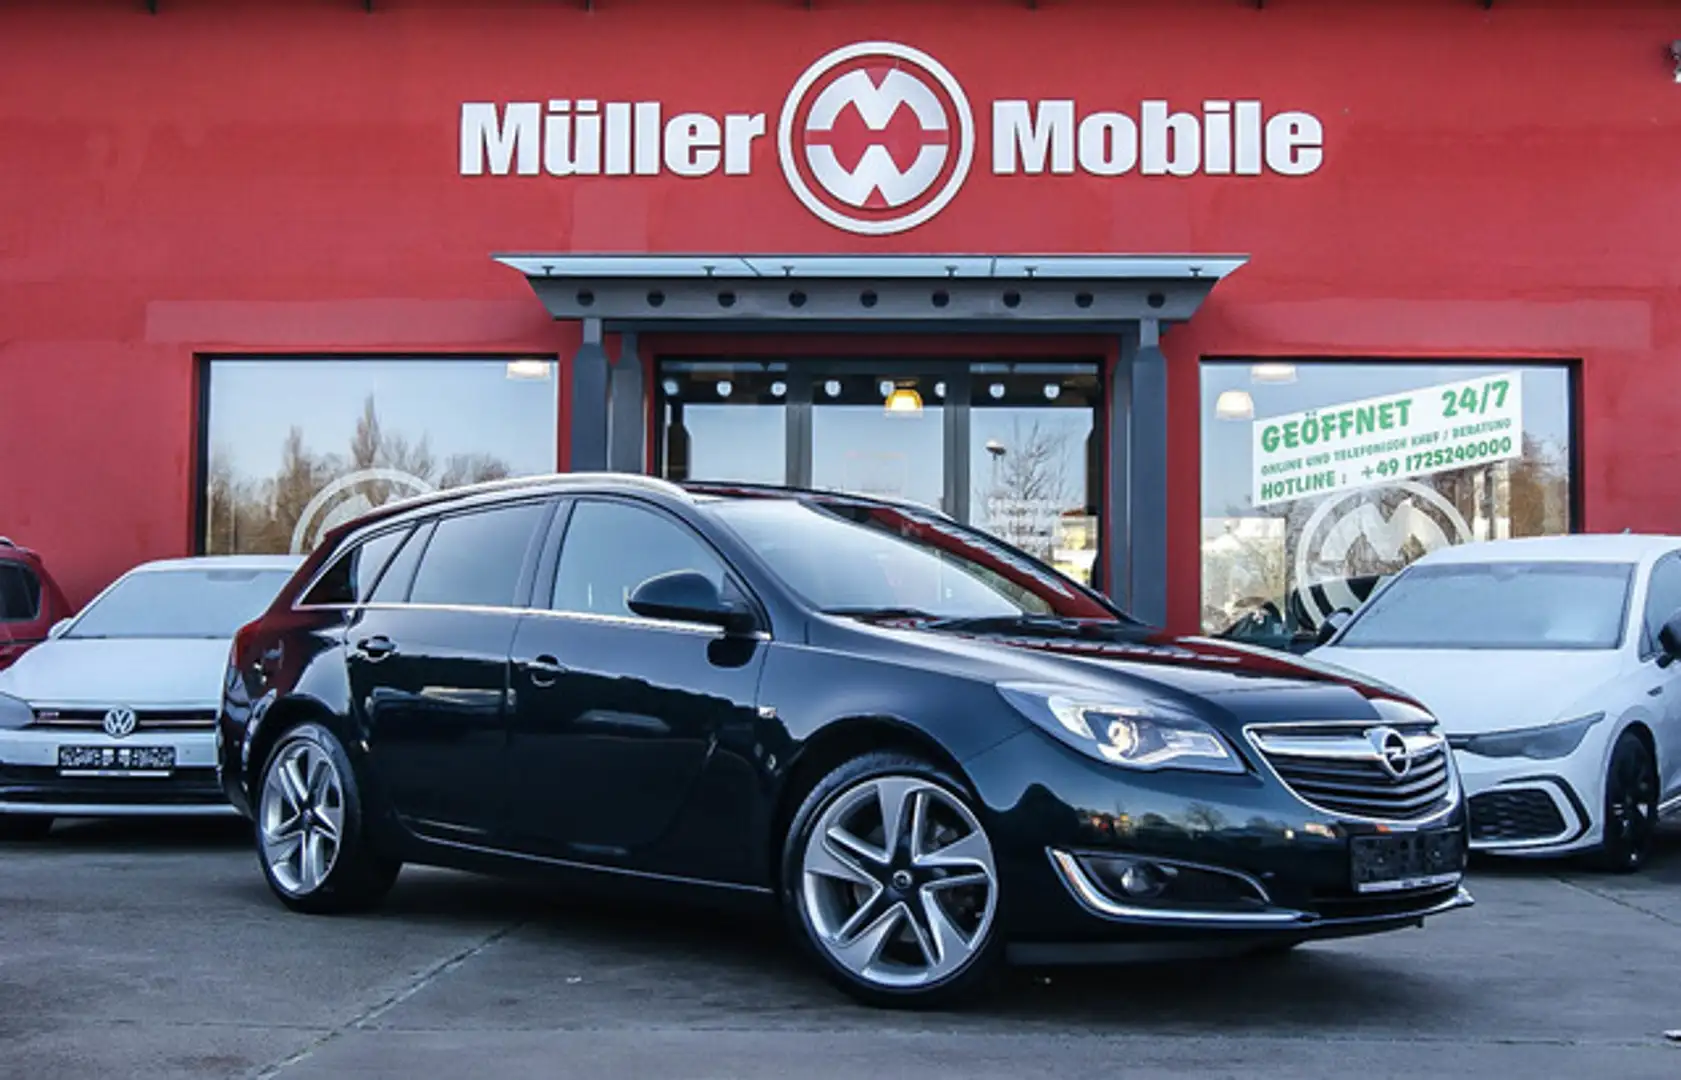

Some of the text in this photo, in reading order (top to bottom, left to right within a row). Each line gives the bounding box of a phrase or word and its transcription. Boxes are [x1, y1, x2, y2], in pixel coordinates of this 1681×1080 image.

[460, 99, 1323, 176] Müller Mobile
[1261, 380, 1509, 453] GEÖFFNET 24/7
[1261, 470, 1336, 500] HOTLINE
[1361, 458, 1399, 479] +49
[1405, 437, 1512, 472] 1725240000
